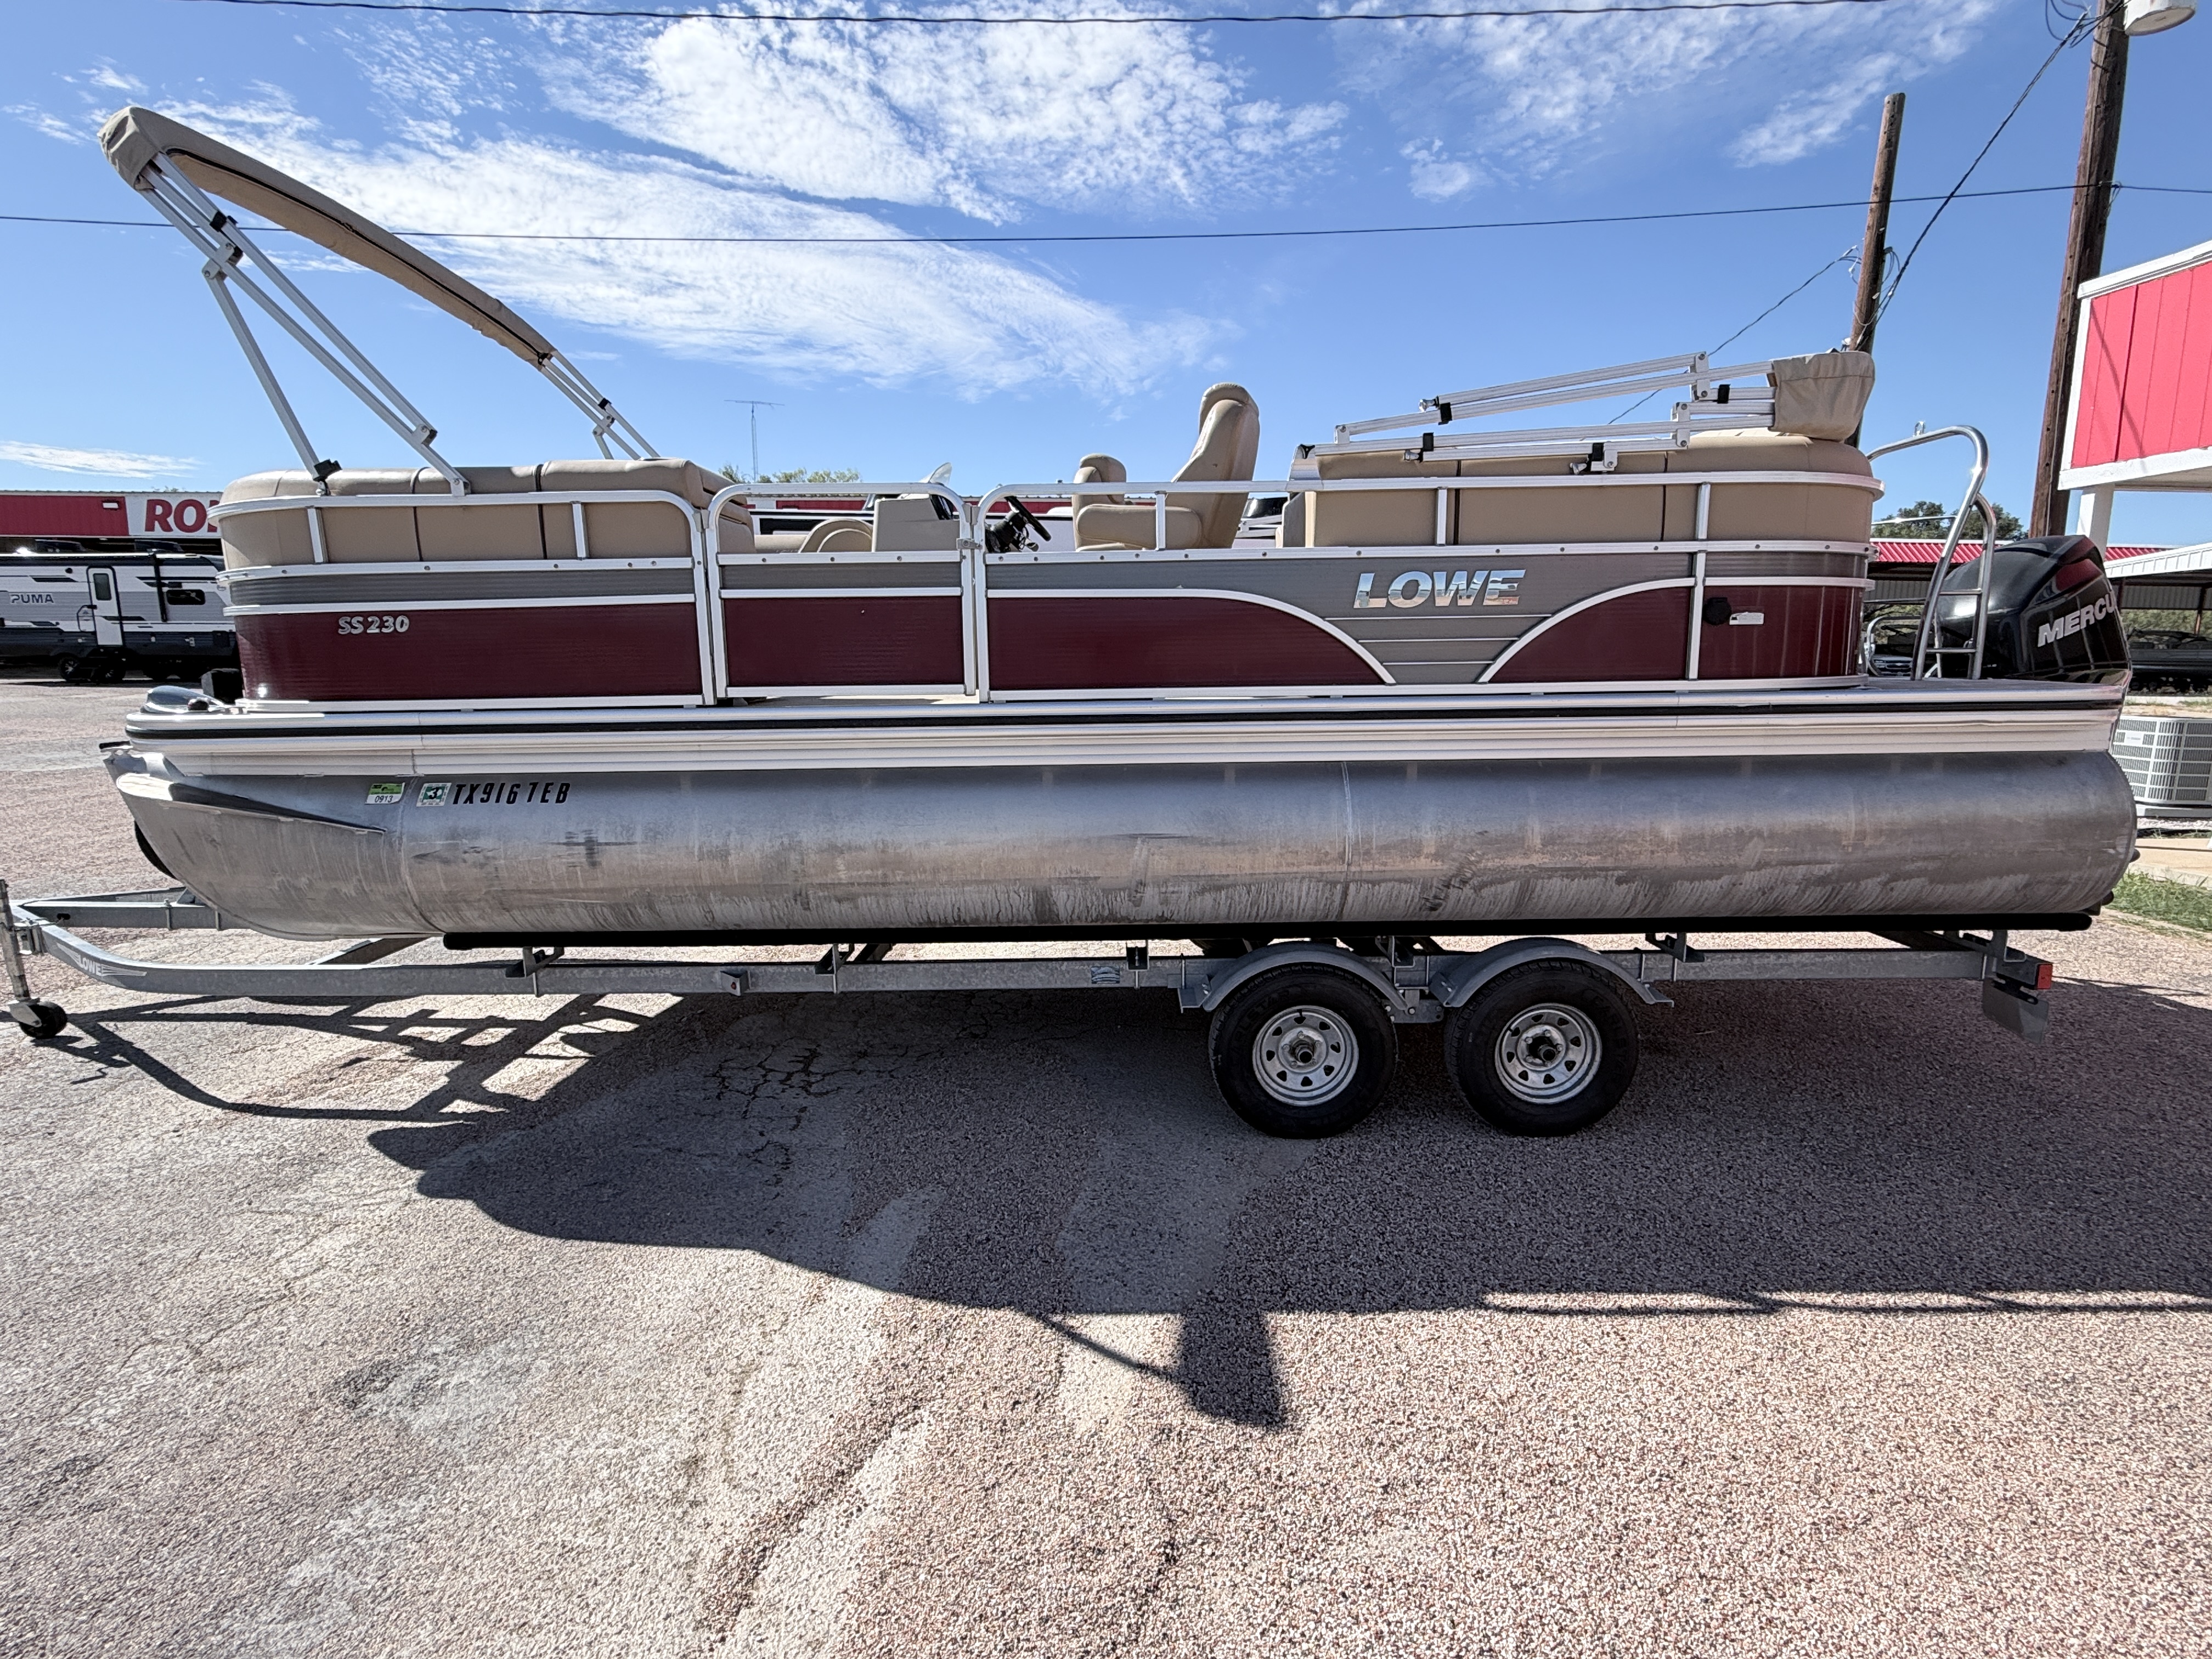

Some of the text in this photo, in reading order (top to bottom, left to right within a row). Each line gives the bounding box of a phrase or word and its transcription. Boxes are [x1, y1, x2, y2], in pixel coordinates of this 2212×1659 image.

[145, 499, 220, 533] RO
[10, 594, 54, 603] PUMA
[1353, 569, 1526, 608] LOWE
[428, 786, 439, 800] 3
[78, 955, 103, 976] LOWE
